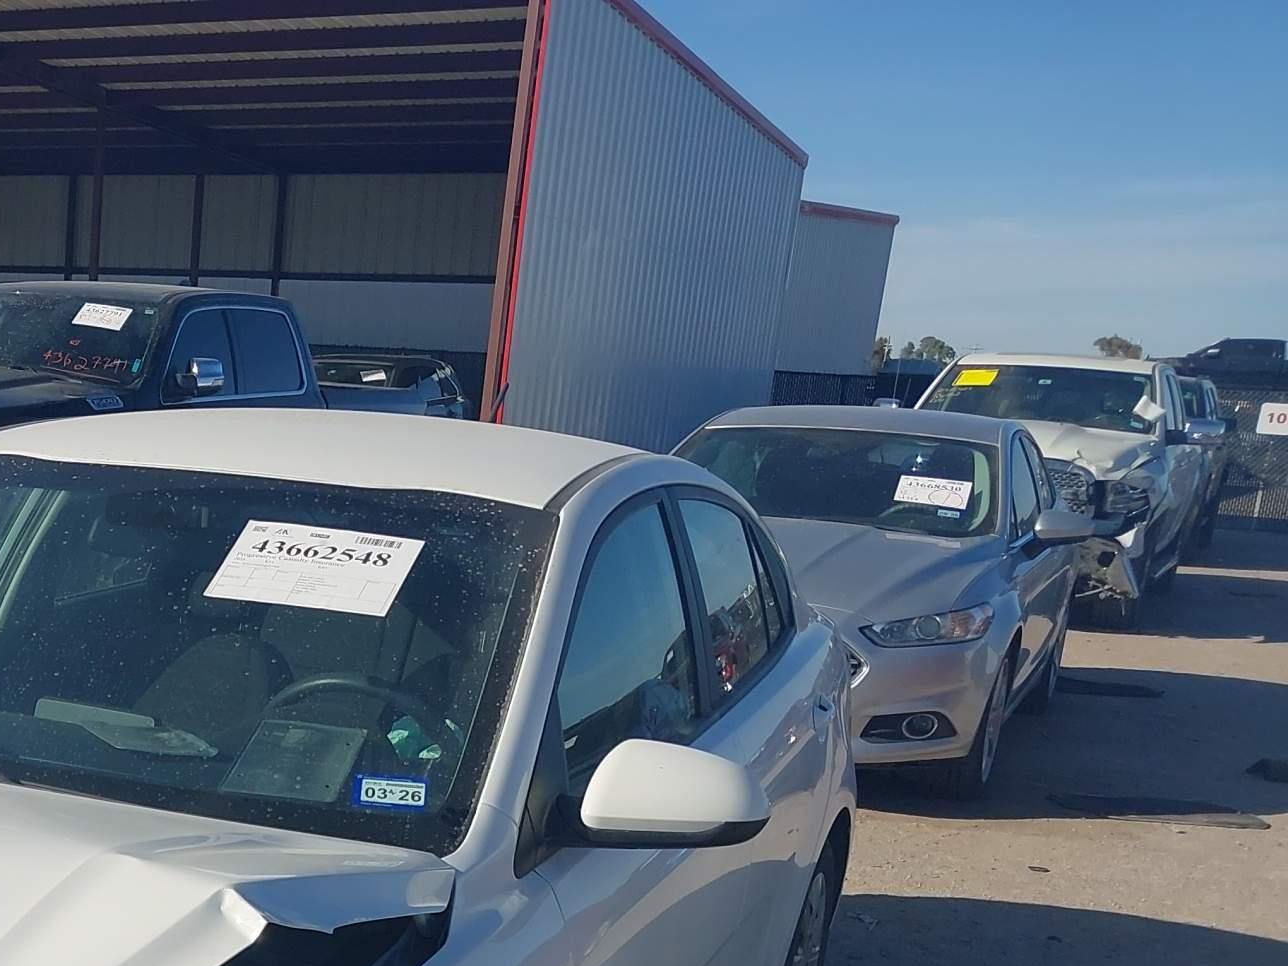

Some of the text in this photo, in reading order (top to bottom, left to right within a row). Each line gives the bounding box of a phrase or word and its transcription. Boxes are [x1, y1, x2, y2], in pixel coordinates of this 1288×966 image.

[252, 538, 392, 567] 43662548
[364, 786, 388, 800] 03
[398, 789, 422, 802] 26
